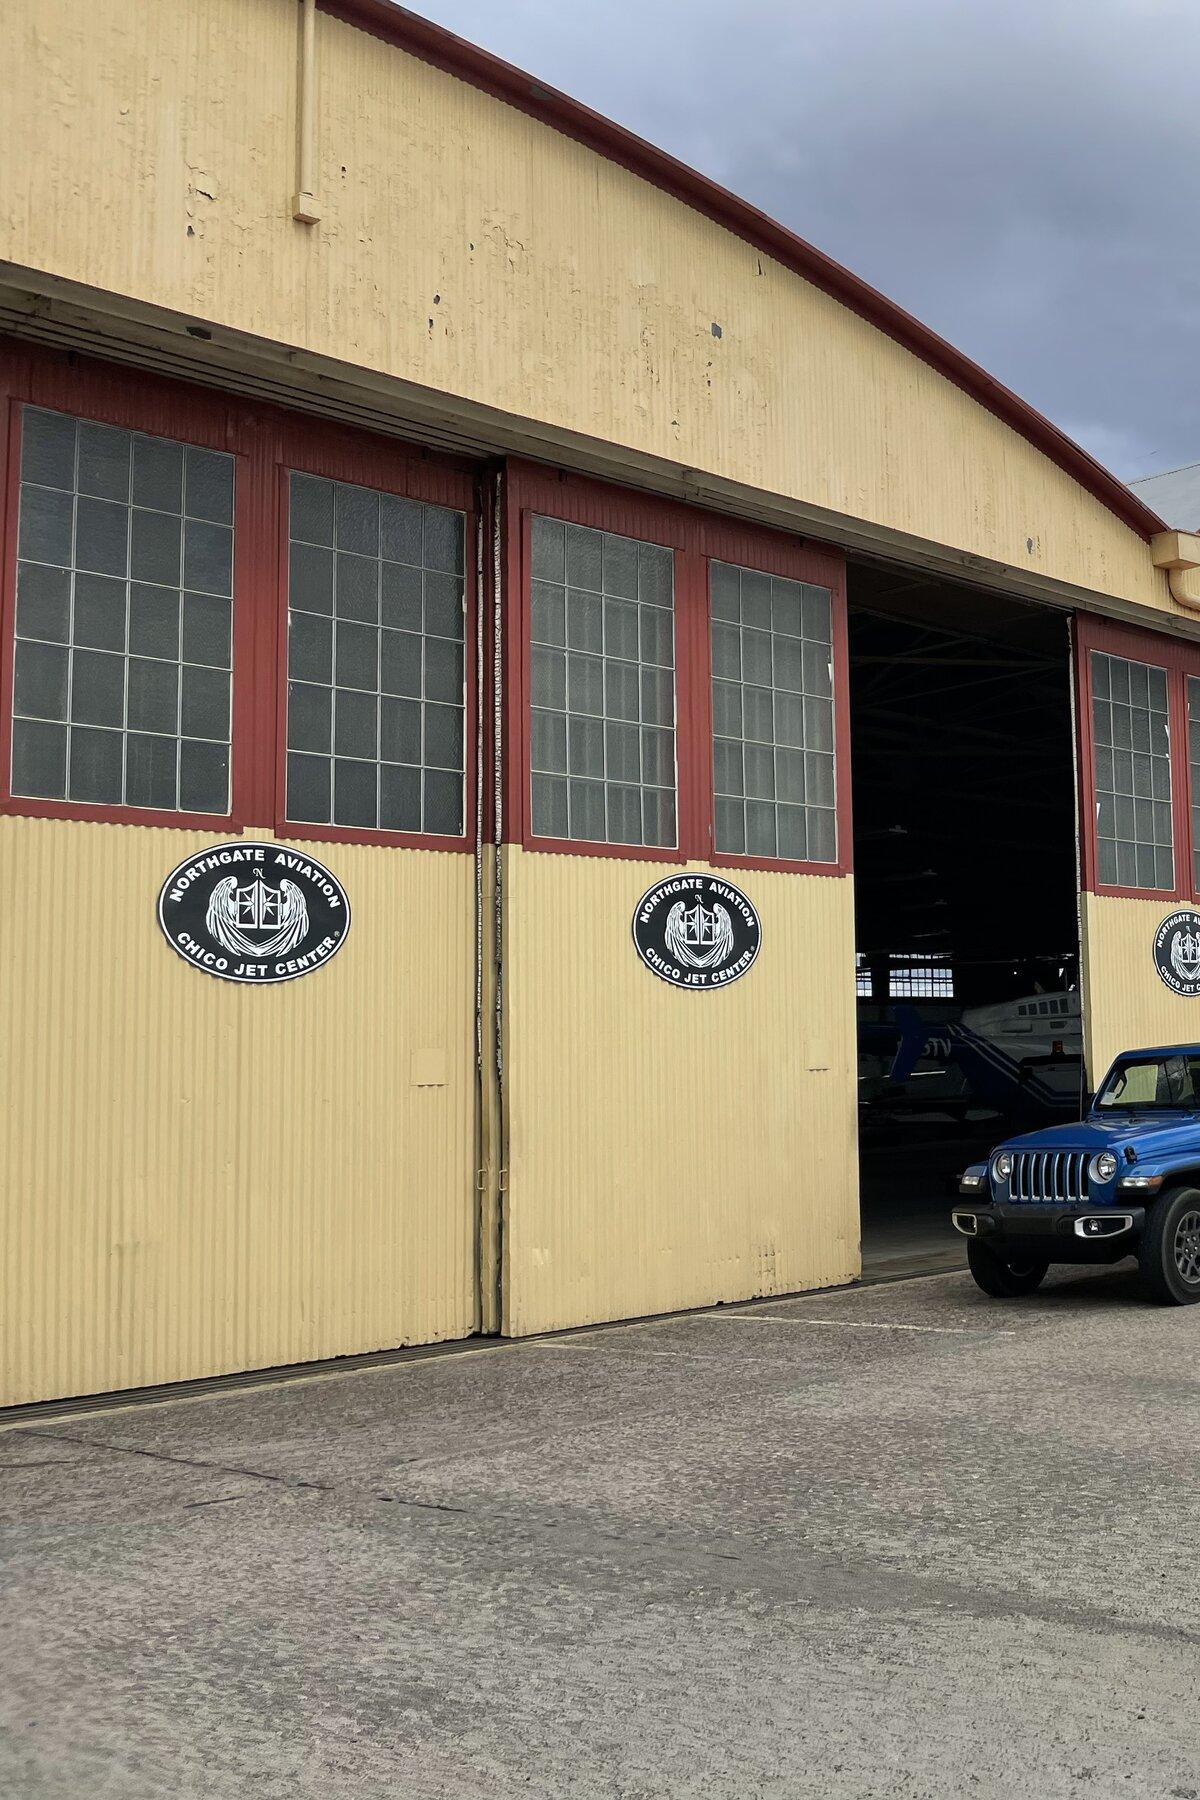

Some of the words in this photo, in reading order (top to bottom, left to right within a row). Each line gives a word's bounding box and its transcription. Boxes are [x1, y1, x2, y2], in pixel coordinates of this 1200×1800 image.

[170, 850, 265, 902] NORTHGATE
[274, 853, 341, 909] AVIATION
[640, 879, 703, 924] NORTHGATE
[709, 882, 755, 927] AVIATION
[1157, 914, 1190, 948] NORTHGATE
[177, 932, 228, 970] CHICO
[234, 964, 268, 976] JET
[275, 935, 336, 975] CENTER
[645, 948, 680, 979] CHICO
[684, 973, 706, 984] JET
[711, 950, 752, 983] CENTER
[1161, 965, 1180, 988] CHICO
[1182, 984, 1195, 992] JET
